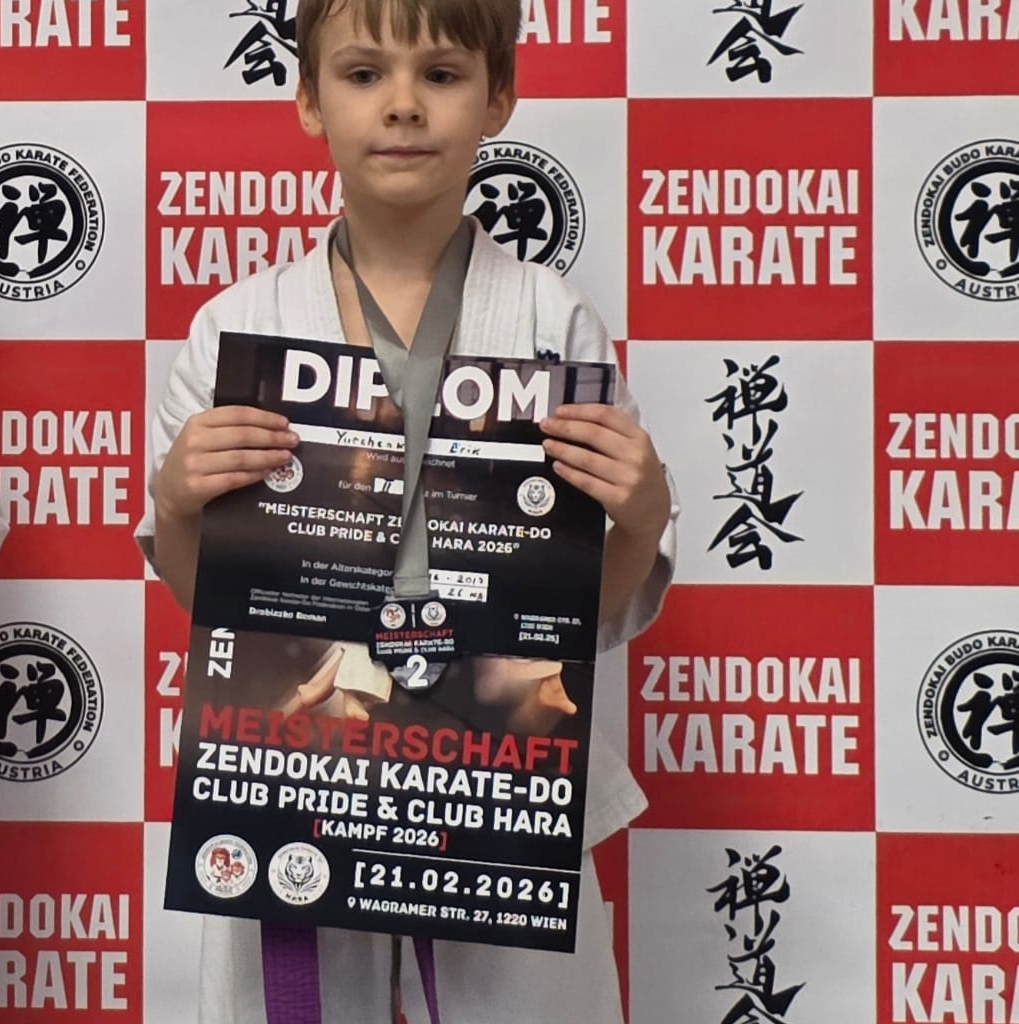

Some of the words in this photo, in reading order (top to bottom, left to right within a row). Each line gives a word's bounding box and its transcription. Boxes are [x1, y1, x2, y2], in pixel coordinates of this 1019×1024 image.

[639, 169, 858, 214] ZENDOKAI
[643, 226, 856, 285] KARATE
[282, 349, 550, 423] DIPOM
[288, 522, 326, 537] CLUB
[330, 526, 373, 543] PRIDE
[376, 532, 386, 543] &
[432, 537, 474, 552] HARA
[468, 523, 552, 540] KARATE-DO
[376, 629, 454, 641] MEISTERSCHAFT
[406, 654, 429, 688] 2
[642, 657, 860, 703] ZENDOKAI
[199, 703, 579, 775] MEISTERSCHAFT
[645, 714, 859, 775] KARATE
[197, 742, 370, 787] ZENDOKAI
[380, 761, 573, 806] KARATE-DO
[192, 776, 269, 806] CLUB
[278, 785, 369, 817] PRIDE
[377, 796, 398, 820] &
[407, 799, 484, 828] CLUB
[493, 807, 573, 838] HARA
[313, 818, 389, 841] [KAMPF
[392, 826, 447, 852] 2026]
[354, 861, 570, 909] [21.02.2026]
[359, 897, 436, 918] WAGRAMER
[440, 906, 470, 922] STR.
[473, 910, 493, 925] 27,
[497, 912, 528, 928] 1220
[531, 916, 567, 930] WIEN
